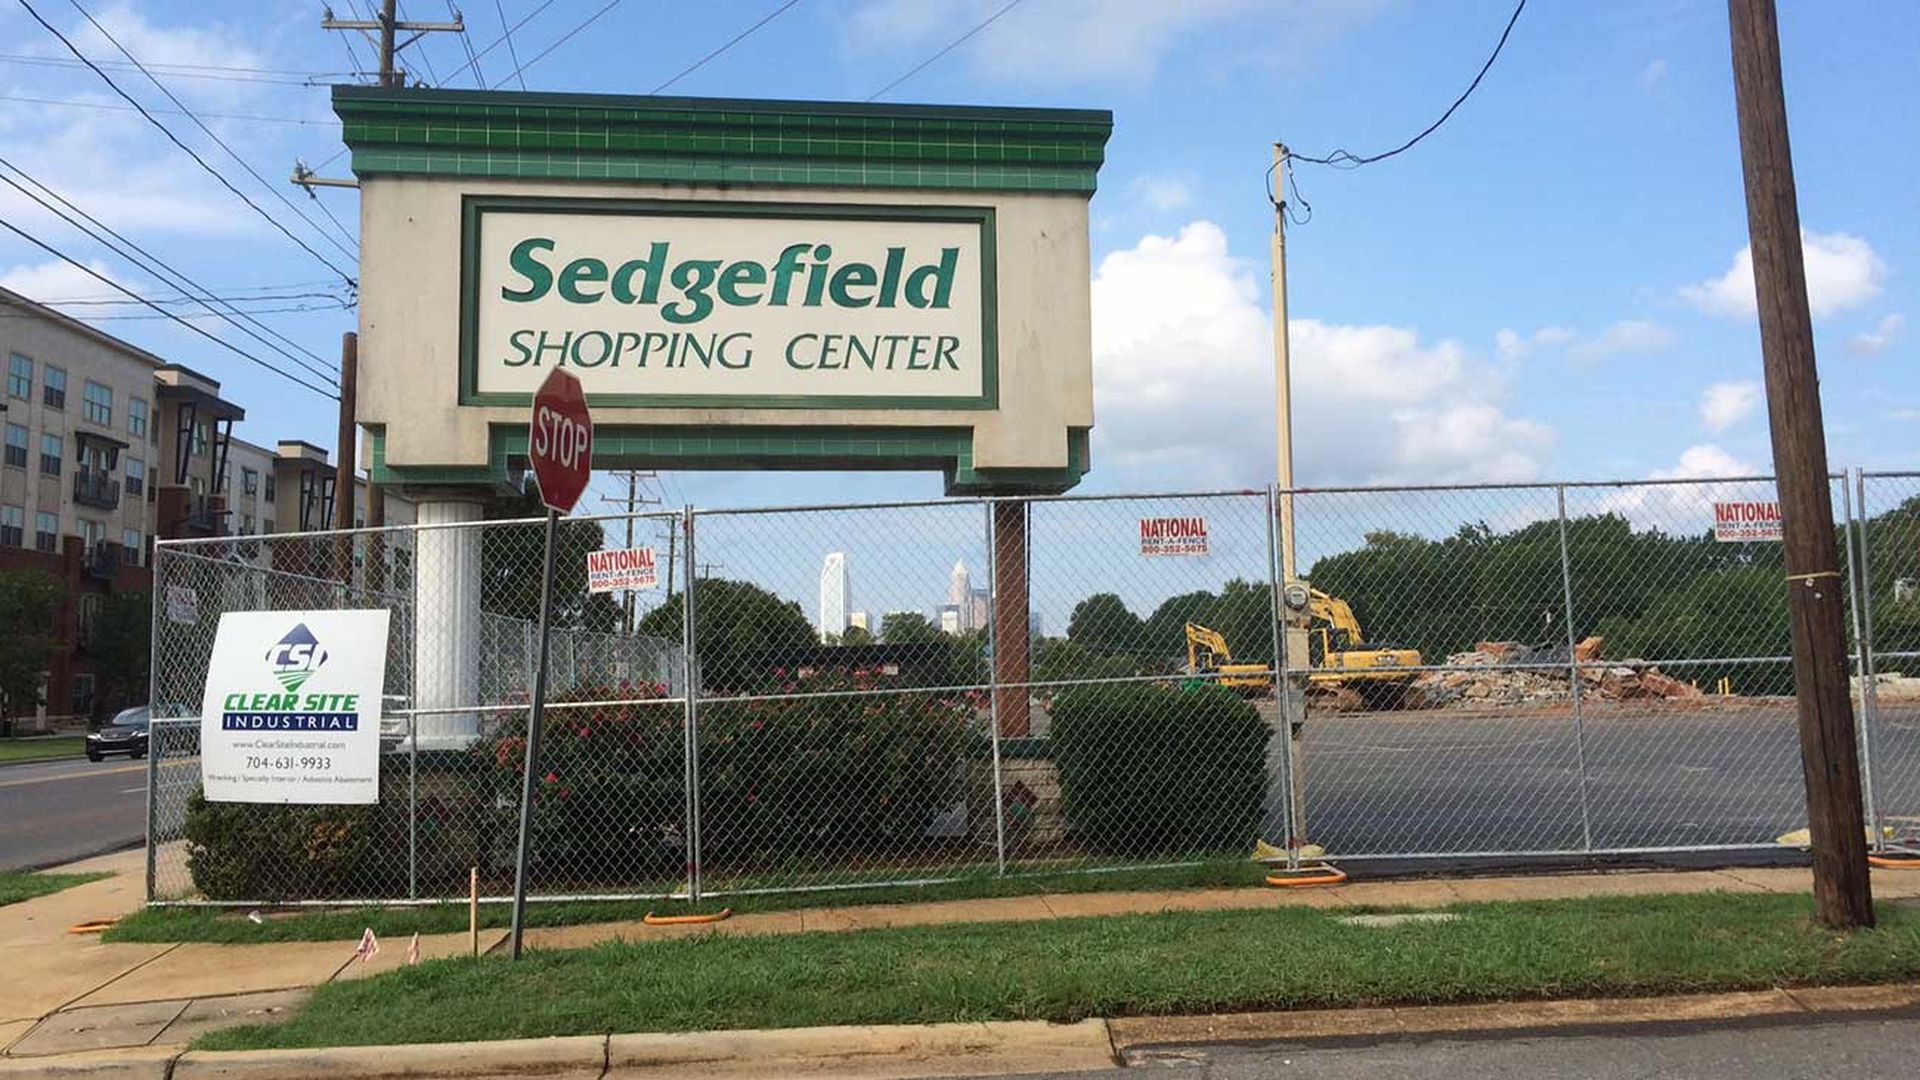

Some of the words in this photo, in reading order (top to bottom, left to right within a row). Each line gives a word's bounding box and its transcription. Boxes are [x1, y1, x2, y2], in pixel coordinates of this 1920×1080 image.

[501, 237, 961, 324] Sedgefield
[503, 329, 753, 370] SHOPPING
[785, 332, 961, 371] CENTER
[536, 405, 588, 471] STOP
[1715, 503, 1783, 521] NATIONAL
[1141, 518, 1207, 537] NATIONAL
[590, 548, 654, 572] NATIONAL
[591, 568, 654, 579] RENT-A-FENCE
[269, 643, 322, 671] CSI
[223, 693, 299, 711] CLEAR
[303, 694, 359, 711] SITE
[226, 716, 354, 729] INDUSTRIAL
[246, 756, 331, 769] 704-631-9933
